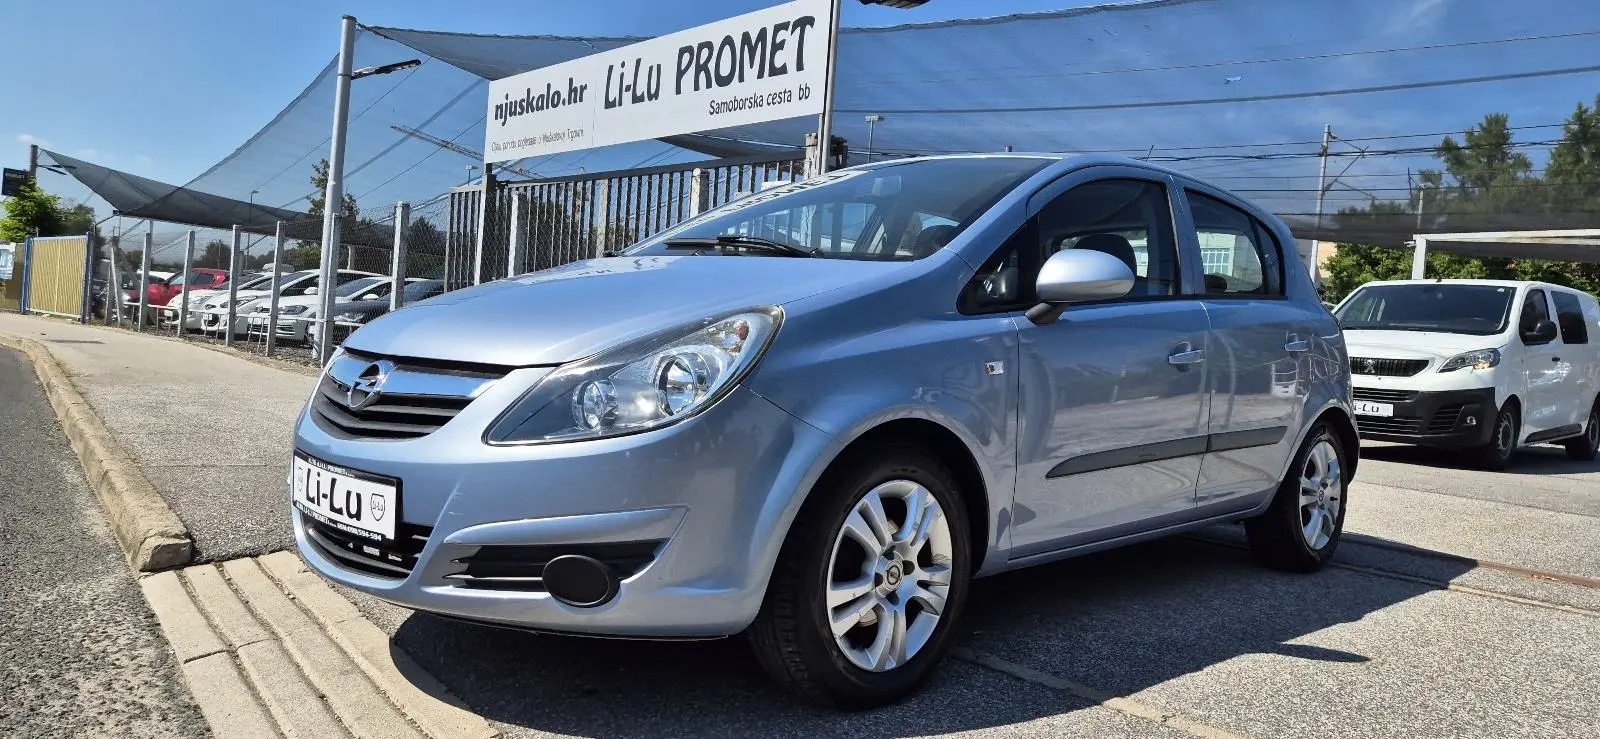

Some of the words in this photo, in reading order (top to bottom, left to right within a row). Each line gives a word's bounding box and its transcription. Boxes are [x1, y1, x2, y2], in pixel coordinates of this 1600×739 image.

[604, 57, 662, 110] Li-Lu
[675, 15, 816, 96] PROMET
[494, 77, 588, 127] njuskalo.hr
[709, 92, 764, 115] Samoborska
[766, 87, 792, 106] cesta
[798, 82, 811, 101] bb
[306, 467, 362, 522] Li-Lu
